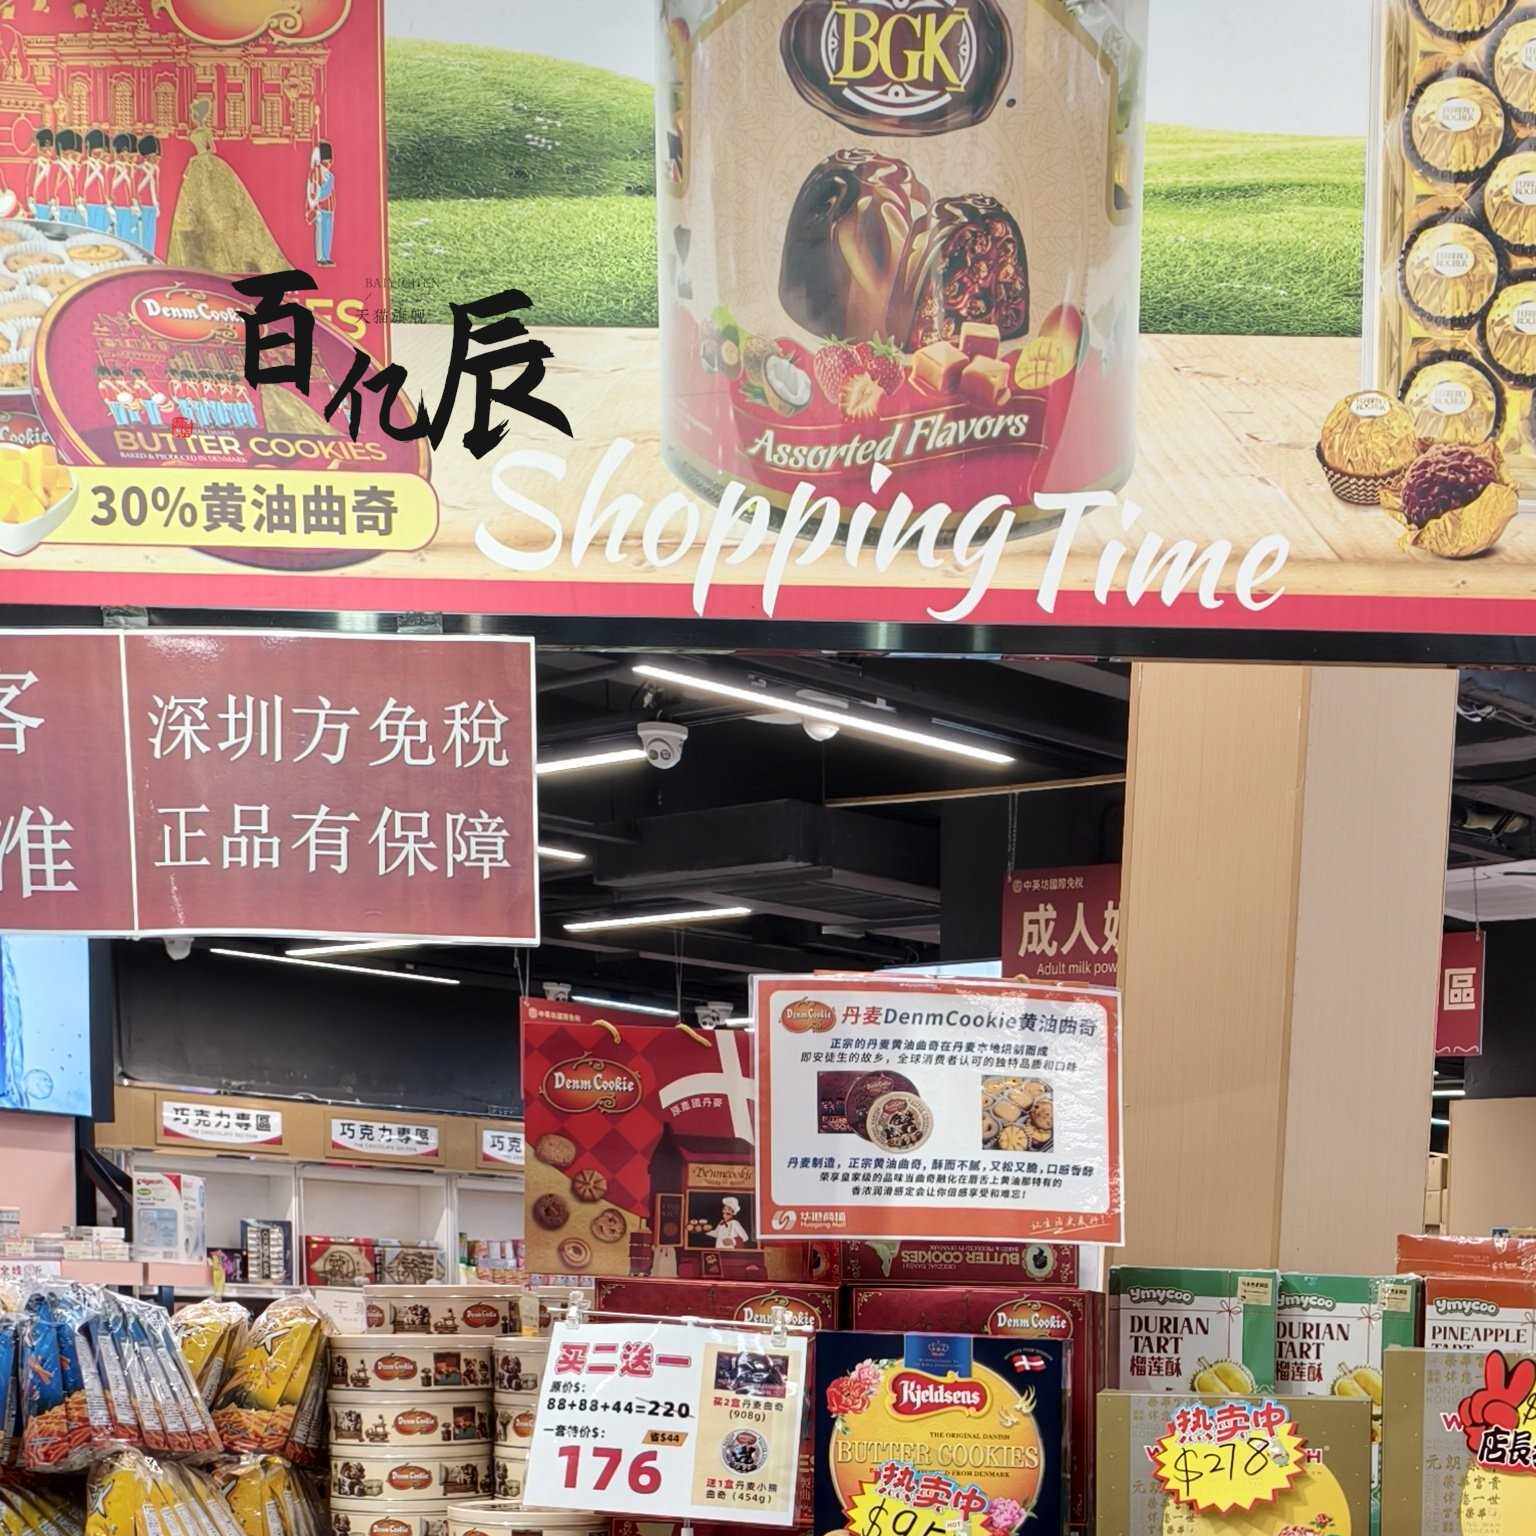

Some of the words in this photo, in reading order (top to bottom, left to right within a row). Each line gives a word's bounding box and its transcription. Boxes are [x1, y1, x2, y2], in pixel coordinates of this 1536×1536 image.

[837, 4, 971, 84] BGK
[114, 430, 241, 456] BUTTER
[249, 436, 388, 461] COOKIES
[747, 417, 898, 471] Assorted
[903, 408, 1029, 460] Flavors
[90, 482, 399, 536] 30%黄油曲奇
[154, 804, 512, 880] 正品有保障
[1036, 962, 1065, 976] Adult
[1068, 960, 1091, 974] milk
[1443, 967, 1476, 1011] 區
[841, 1005, 1098, 1039] 丹麦DenmCookie黄油曲奇
[1129, 1286, 1194, 1305] ymycoo
[1434, 1298, 1500, 1317] ymycoo
[1129, 1314, 1210, 1337] DURIAN
[1275, 1320, 1351, 1343] DURIAN
[1431, 1324, 1528, 1345] PINEAPPLE
[554, 1341, 693, 1379] 买二送一
[1129, 1336, 1184, 1355] TART
[1275, 1341, 1325, 1360] TART
[1129, 1356, 1183, 1377] 榴莲酥
[1275, 1361, 1324, 1382] 榴莲酥
[546, 1397, 692, 1420] 88+88+44=220
[898, 1379, 982, 1410] Kjeldsens
[1174, 1402, 1287, 1445] 热卖中
[558, 1444, 663, 1495] 176
[836, 1440, 932, 1467] BUTTER
[938, 1444, 1042, 1470] COOKIES
[1172, 1437, 1271, 1497] $278
[877, 1462, 988, 1521] 热卖中
